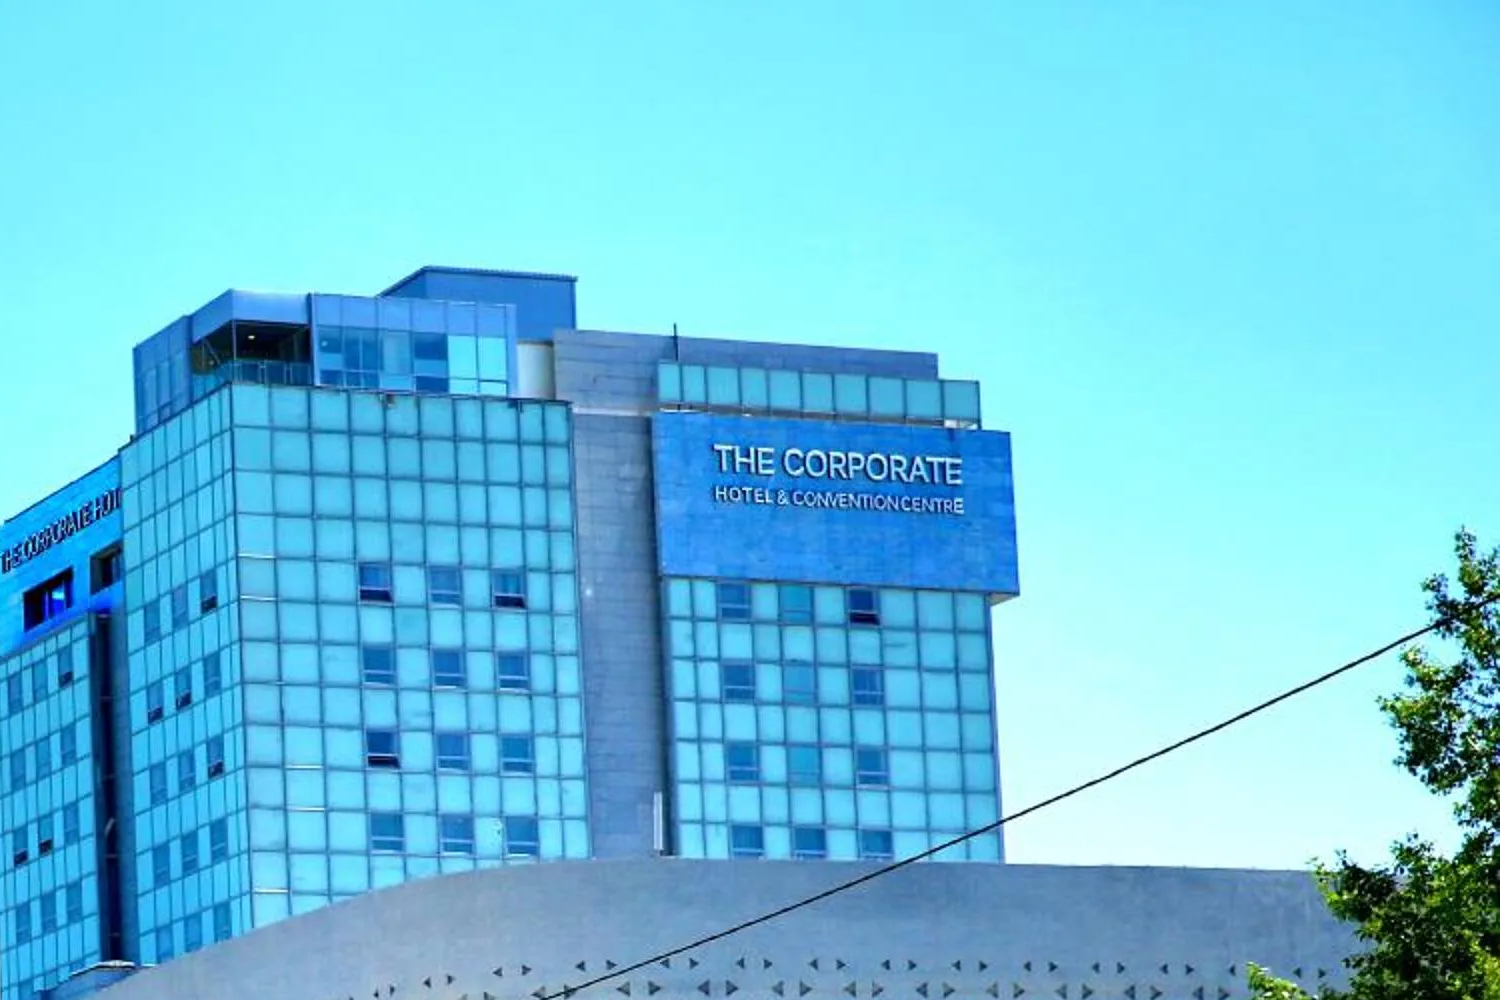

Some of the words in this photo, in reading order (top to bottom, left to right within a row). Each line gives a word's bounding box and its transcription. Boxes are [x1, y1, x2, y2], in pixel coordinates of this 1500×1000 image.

[713, 443, 775, 475] THE
[783, 448, 963, 485] CORPORATE
[714, 486, 773, 503] HOTEL
[777, 489, 789, 505] &
[792, 491, 899, 512] CONVENTION
[901, 495, 964, 515] CENTRE
